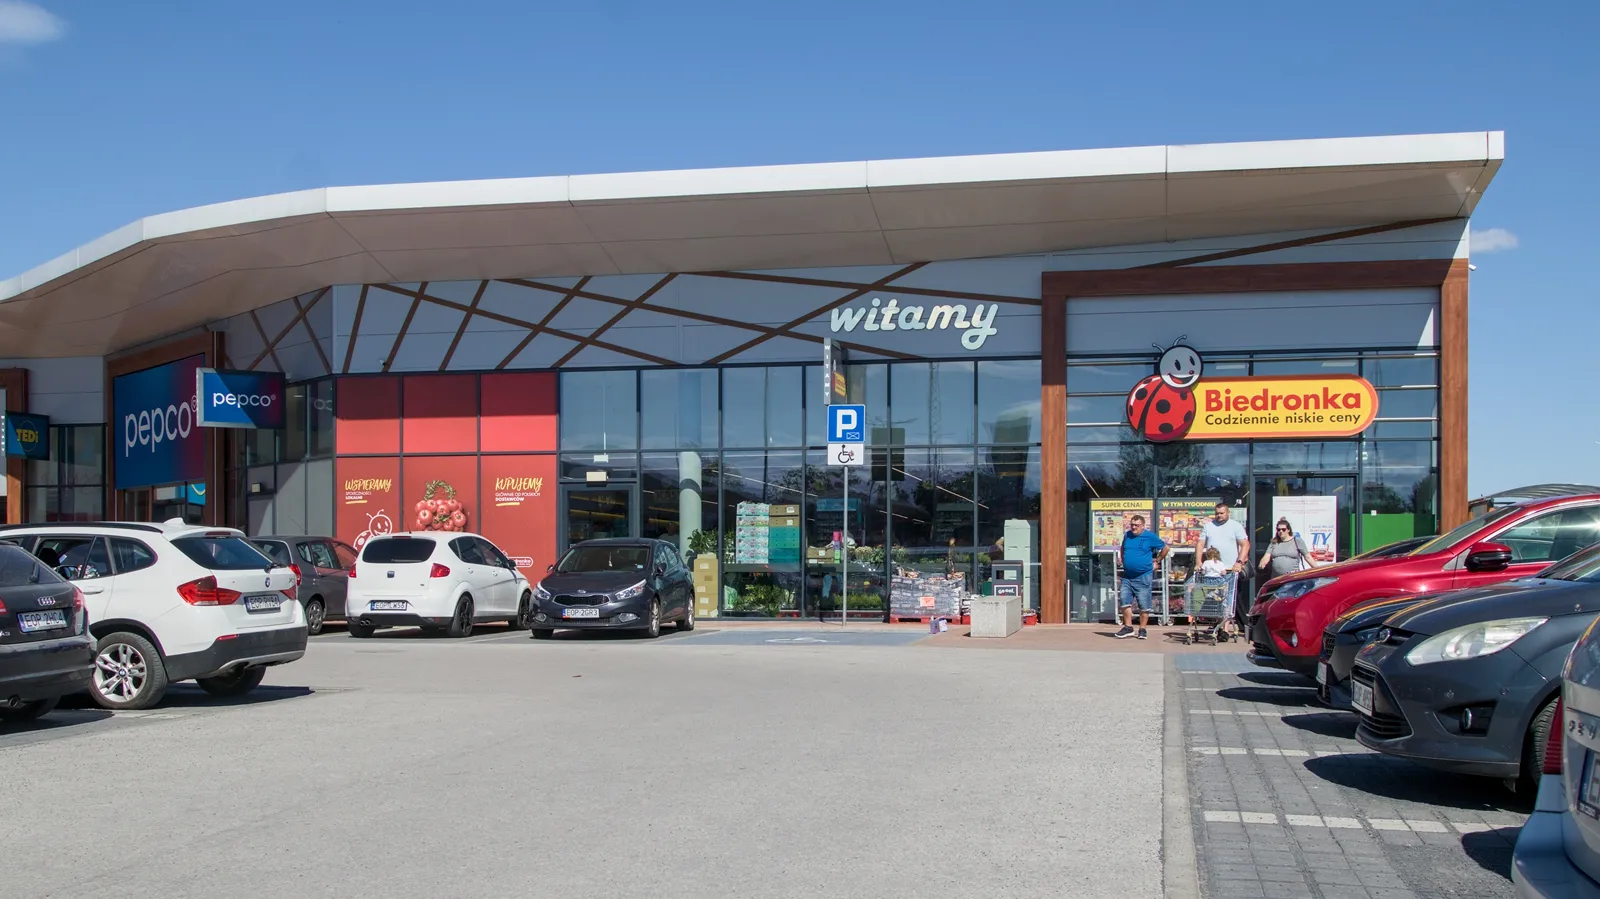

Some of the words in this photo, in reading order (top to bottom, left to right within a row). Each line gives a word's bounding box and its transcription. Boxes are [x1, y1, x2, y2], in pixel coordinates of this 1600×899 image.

[830, 298, 999, 350] witamy
[212, 392, 272, 408] pepco
[1205, 387, 1361, 412] Biedronka
[836, 409, 857, 438] P
[1205, 412, 1280, 426] Codziennie
[1286, 412, 1324, 424] niskie
[1329, 413, 1361, 425] ceny
[16, 428, 39, 443] TEDi
[125, 401, 192, 457] pepco
[344, 478, 392, 492] WSPIERAMY
[495, 476, 543, 493] KUPUJEMY
[1310, 532, 1332, 545] TY
[566, 608, 579, 616] EOP
[580, 608, 598, 616] 2GR3
[24, 613, 41, 627] EOP
